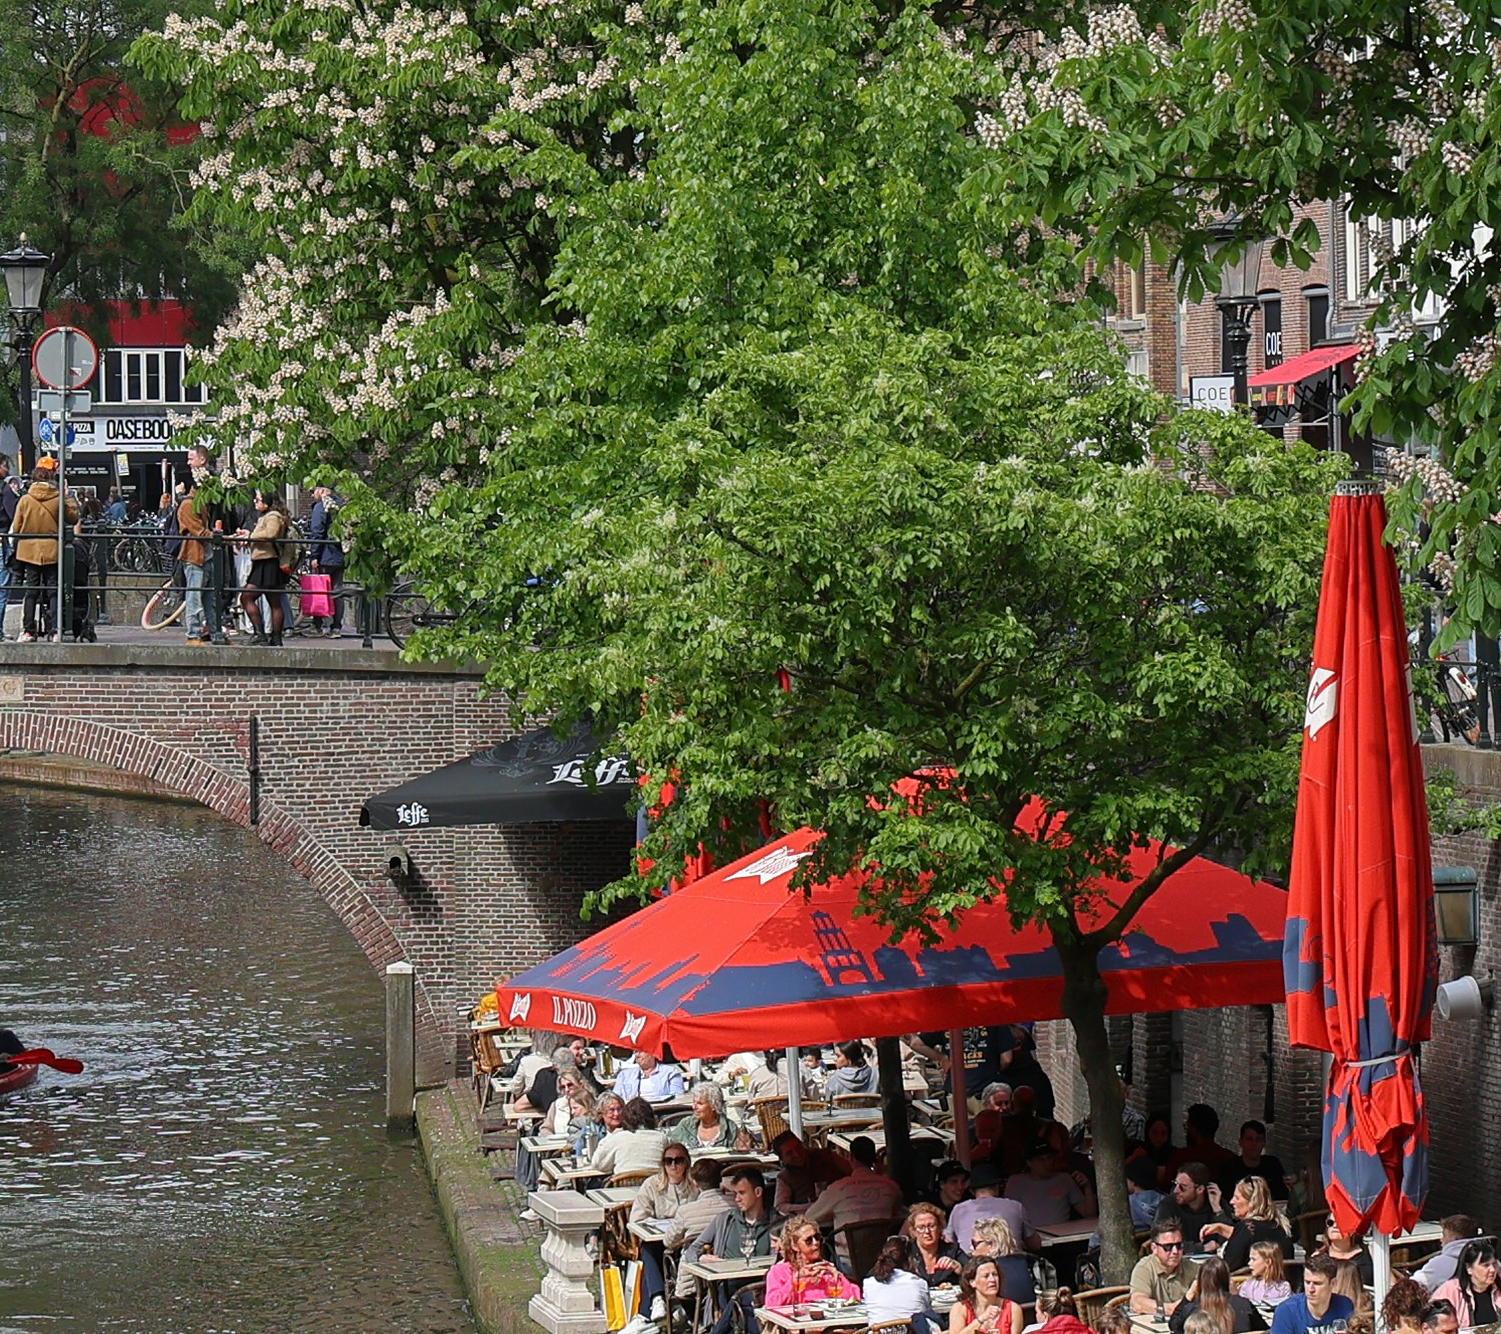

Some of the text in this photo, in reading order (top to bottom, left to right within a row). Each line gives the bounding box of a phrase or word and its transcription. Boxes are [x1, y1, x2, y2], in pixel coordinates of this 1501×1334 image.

[396, 801, 429, 827] Leffe
[552, 996, 564, 1024] IL
[564, 998, 597, 1031] POZZO
